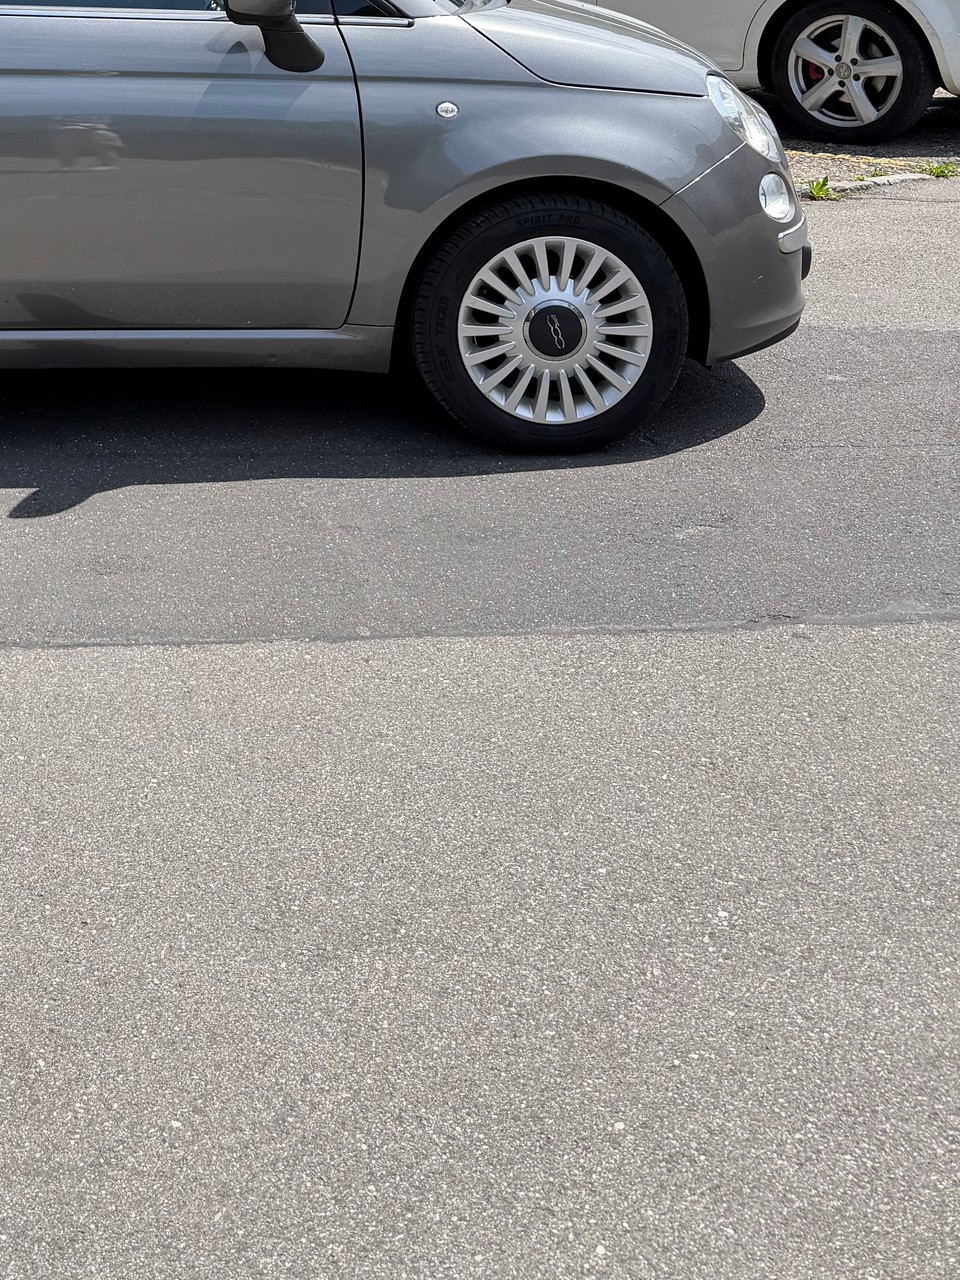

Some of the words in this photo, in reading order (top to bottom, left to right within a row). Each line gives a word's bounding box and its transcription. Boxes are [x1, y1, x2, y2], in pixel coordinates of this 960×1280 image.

[516, 214, 552, 229] SPIRIT
[559, 214, 581, 225] PRO
[435, 296, 450, 336] TECAR
